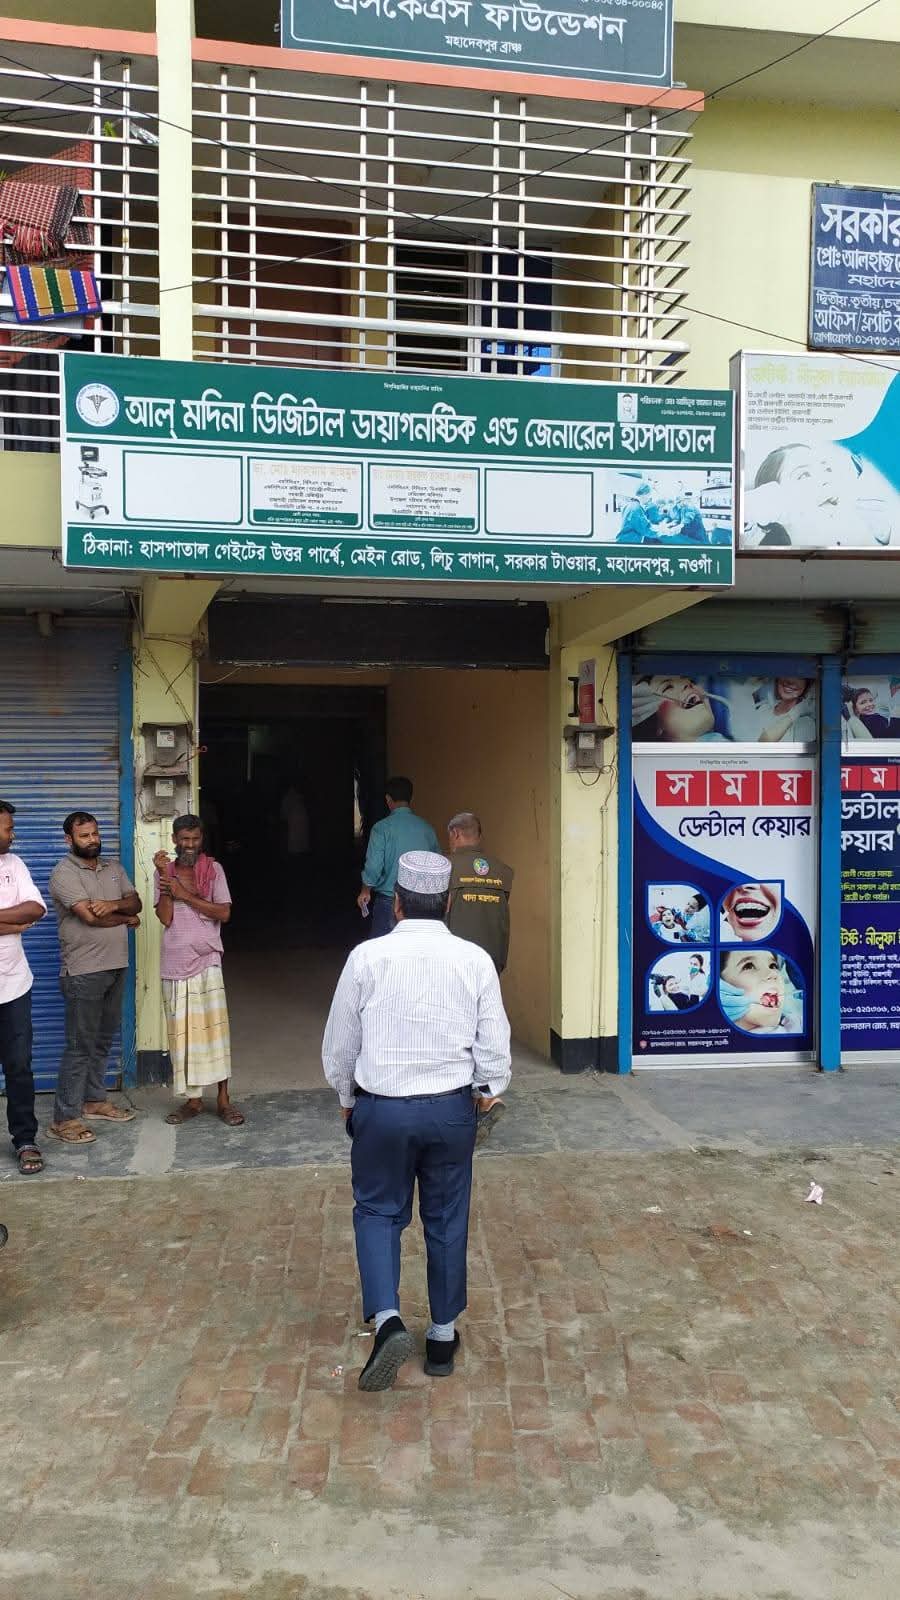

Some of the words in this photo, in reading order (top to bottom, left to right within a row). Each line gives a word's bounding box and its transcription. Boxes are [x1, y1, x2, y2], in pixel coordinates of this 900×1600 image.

[481, 0, 628, 43] ফাউন্ডেশন
[444, 35, 499, 54] মহাদেবপুর
[124, 396, 178, 438] আল্
[181, 388, 245, 432] মদিনা
[251, 391, 346, 438] ডিজিটাল
[350, 402, 476, 444] ডায়াগনষ্টিক
[524, 417, 616, 451] জেনারেল
[619, 423, 717, 454] হাসপাতাল
[82, 532, 133, 557] ঠিকানা:
[139, 539, 209, 561] হাসপাতাল
[215, 541, 265, 562] গেইটের
[270, 543, 302, 562] উত্তর
[350, 545, 385, 566] মেইন
[390, 548, 425, 570] রোড,
[430, 547, 453, 572] লিচু
[457, 552, 499, 571] বাগান,
[504, 553, 547, 571] সরকার
[551, 551, 601, 573] টাওয়ার,
[606, 556, 675, 577] মহাদেবপুর,
[679, 810, 746, 838] ডেন্টাল
[752, 816, 811, 838] কেয়ার
